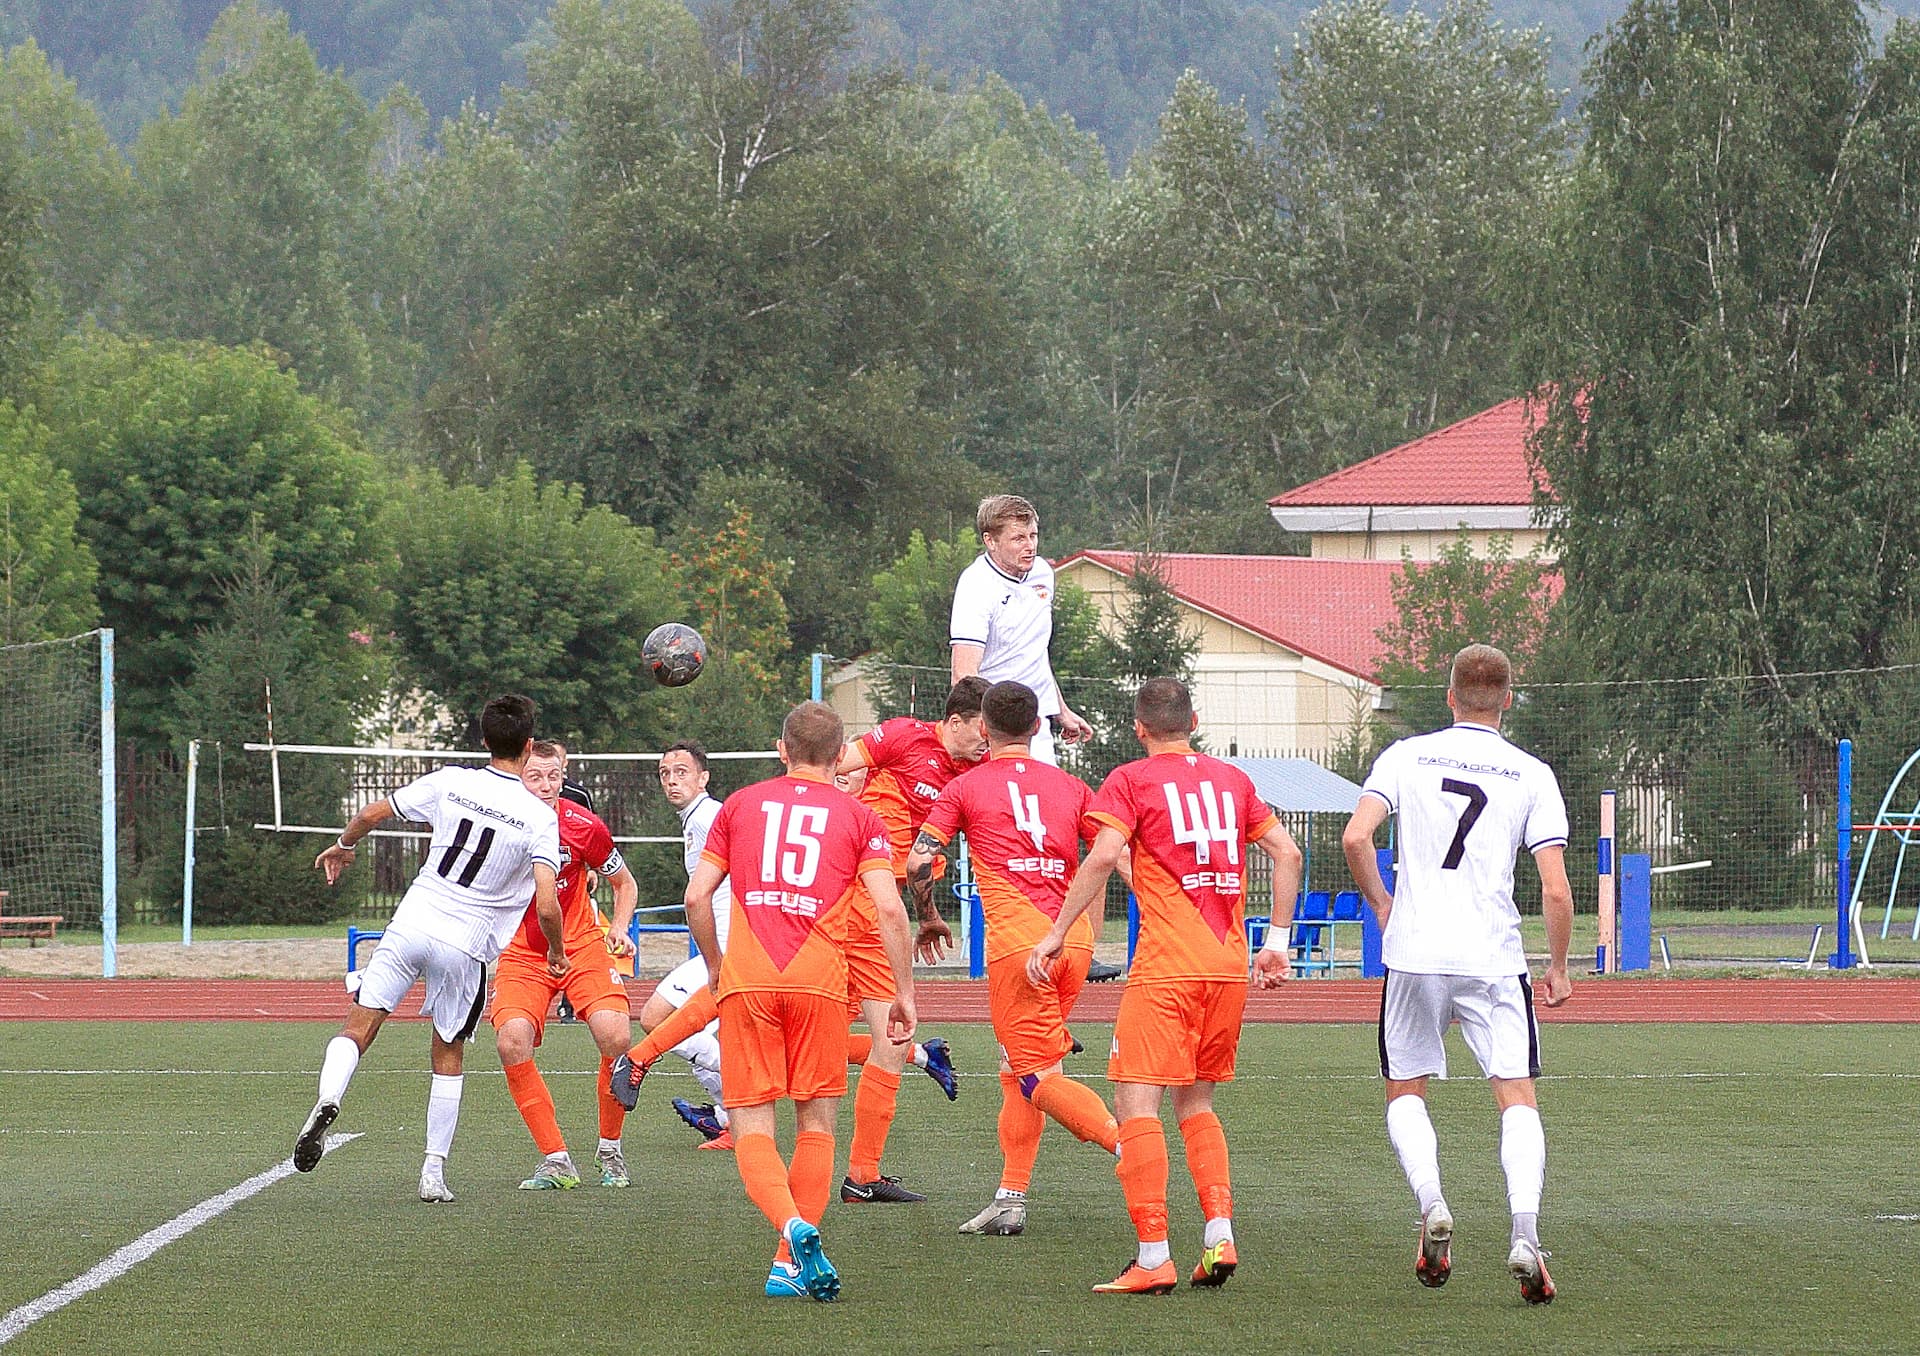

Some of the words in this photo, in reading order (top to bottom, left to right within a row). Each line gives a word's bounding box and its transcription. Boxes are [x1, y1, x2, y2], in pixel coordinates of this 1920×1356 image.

[914, 781, 942, 801] ПРО
[1007, 781, 1047, 853] 4
[1163, 780, 1240, 865] 44
[1441, 778, 1489, 870] 7
[437, 818, 496, 888] 11
[761, 800, 830, 888] 15
[1007, 857, 1066, 873] SEUS
[745, 890, 818, 912] SEUS
[1181, 871, 1240, 890] SEUS
